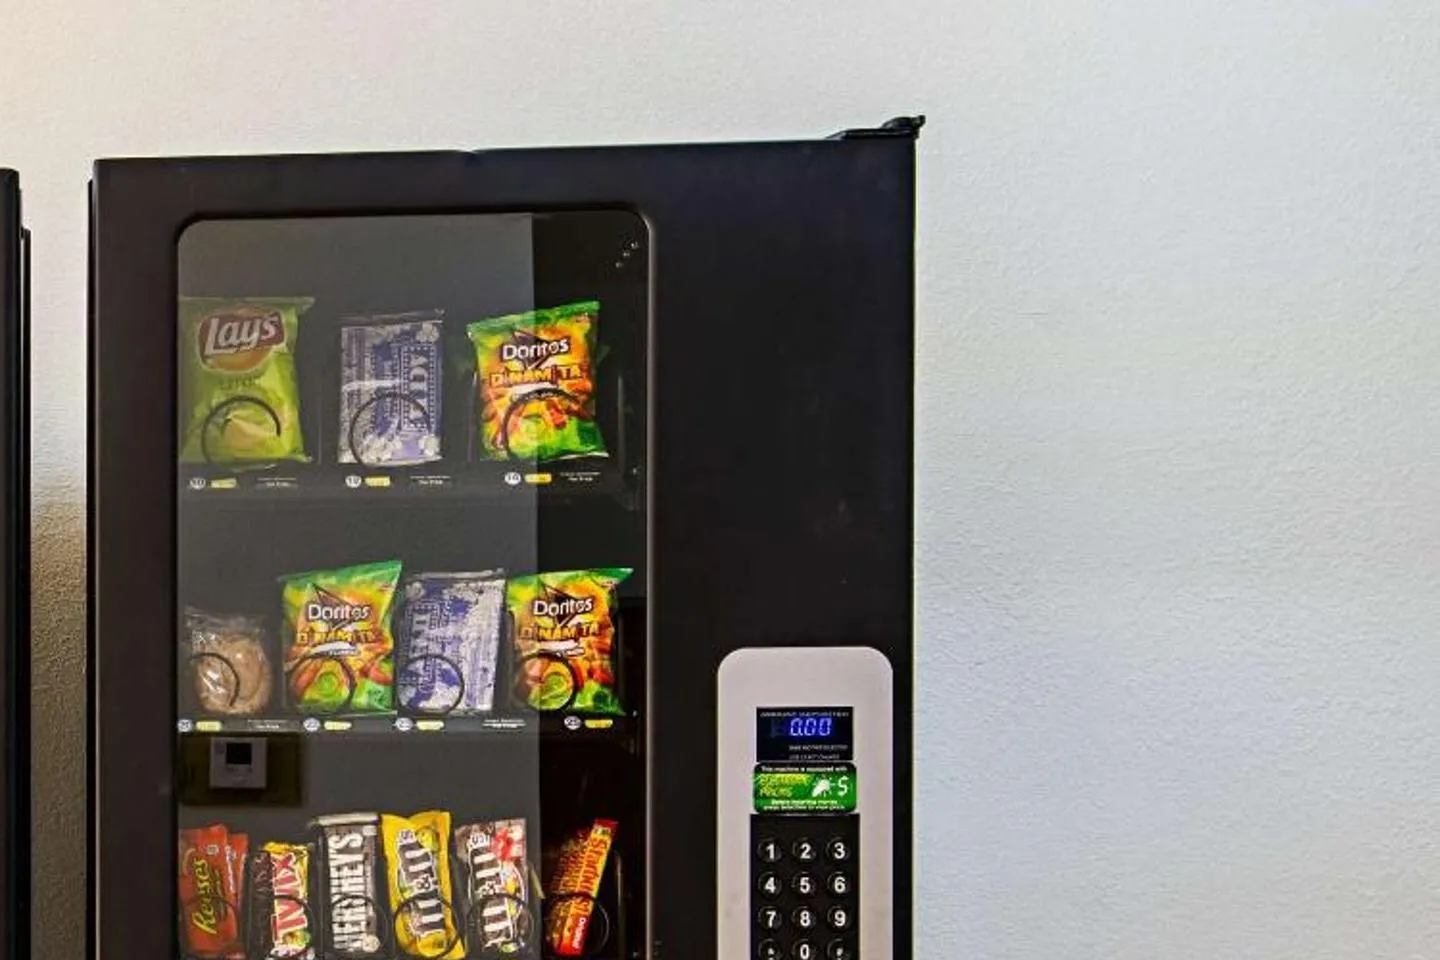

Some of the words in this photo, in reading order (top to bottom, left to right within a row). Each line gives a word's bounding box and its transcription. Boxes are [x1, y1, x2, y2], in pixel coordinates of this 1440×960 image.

[203, 313, 279, 354] Lay's
[502, 338, 569, 360] Doritos
[308, 604, 370, 620] Doritos
[533, 598, 593, 616] Doritos
[790, 718, 832, 736] 0.00
[768, 844, 774, 859] 1
[801, 844, 810, 858] 2
[835, 843, 845, 858] 3
[765, 877, 775, 893] 4
[800, 877, 810, 893] 5
[835, 877, 845, 892] 6
[767, 911, 776, 927] 7
[801, 911, 810, 926] 8
[835, 911, 845, 926] 9
[800, 944, 809, 959] 0
